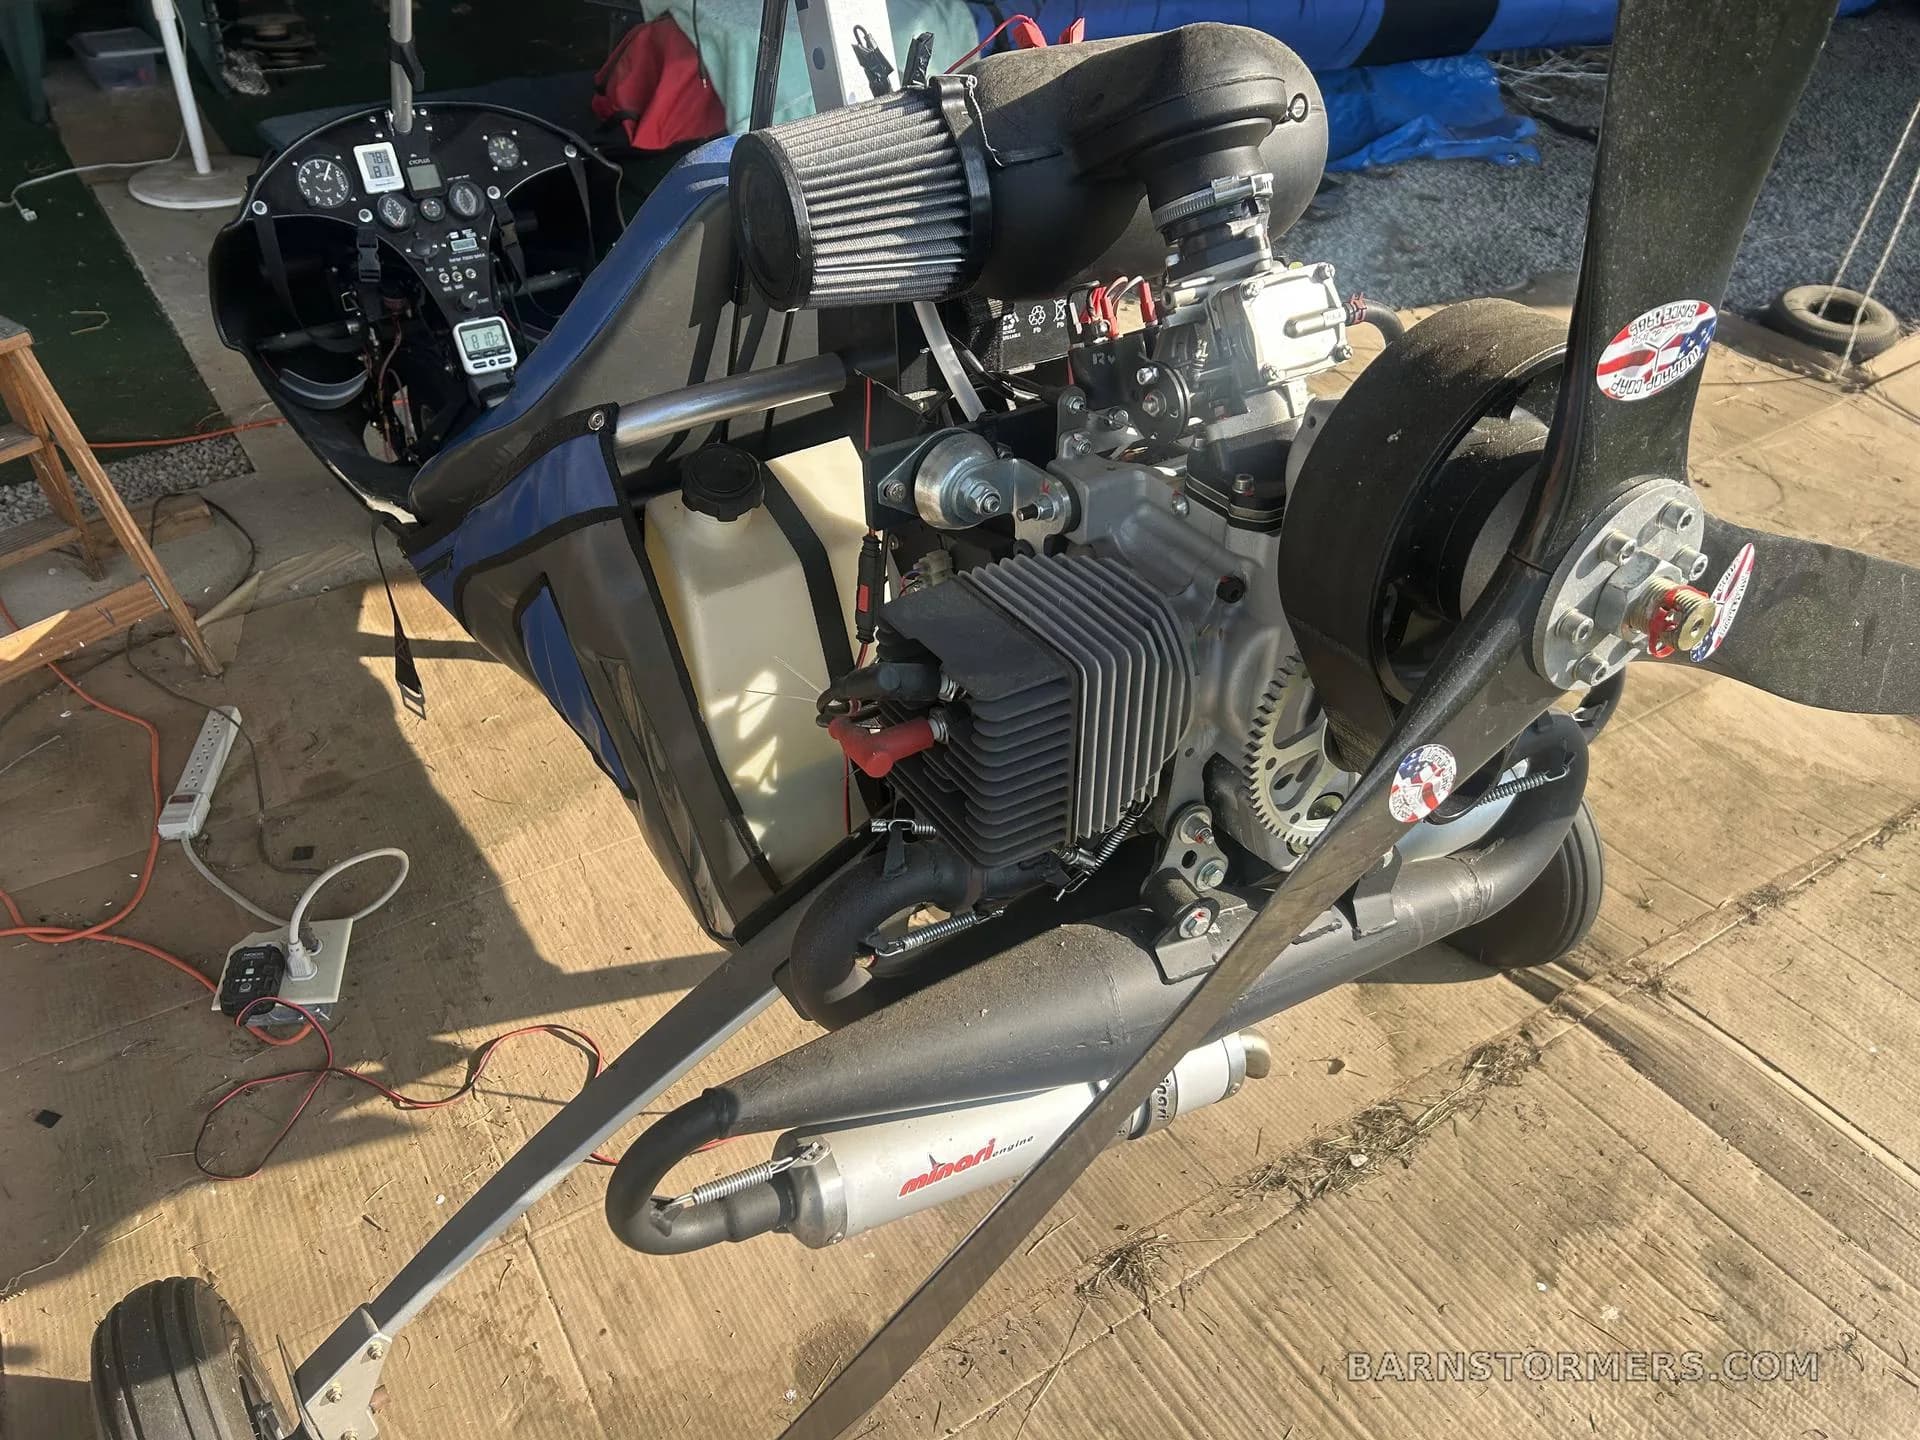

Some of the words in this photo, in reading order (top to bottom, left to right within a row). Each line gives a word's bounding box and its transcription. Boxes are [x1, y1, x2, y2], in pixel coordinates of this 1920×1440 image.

[1630, 311, 1662, 337] 1986
[1665, 304, 1697, 320] SINCE
[898, 1138, 996, 1198] minari
[992, 1136, 1034, 1158] engine
